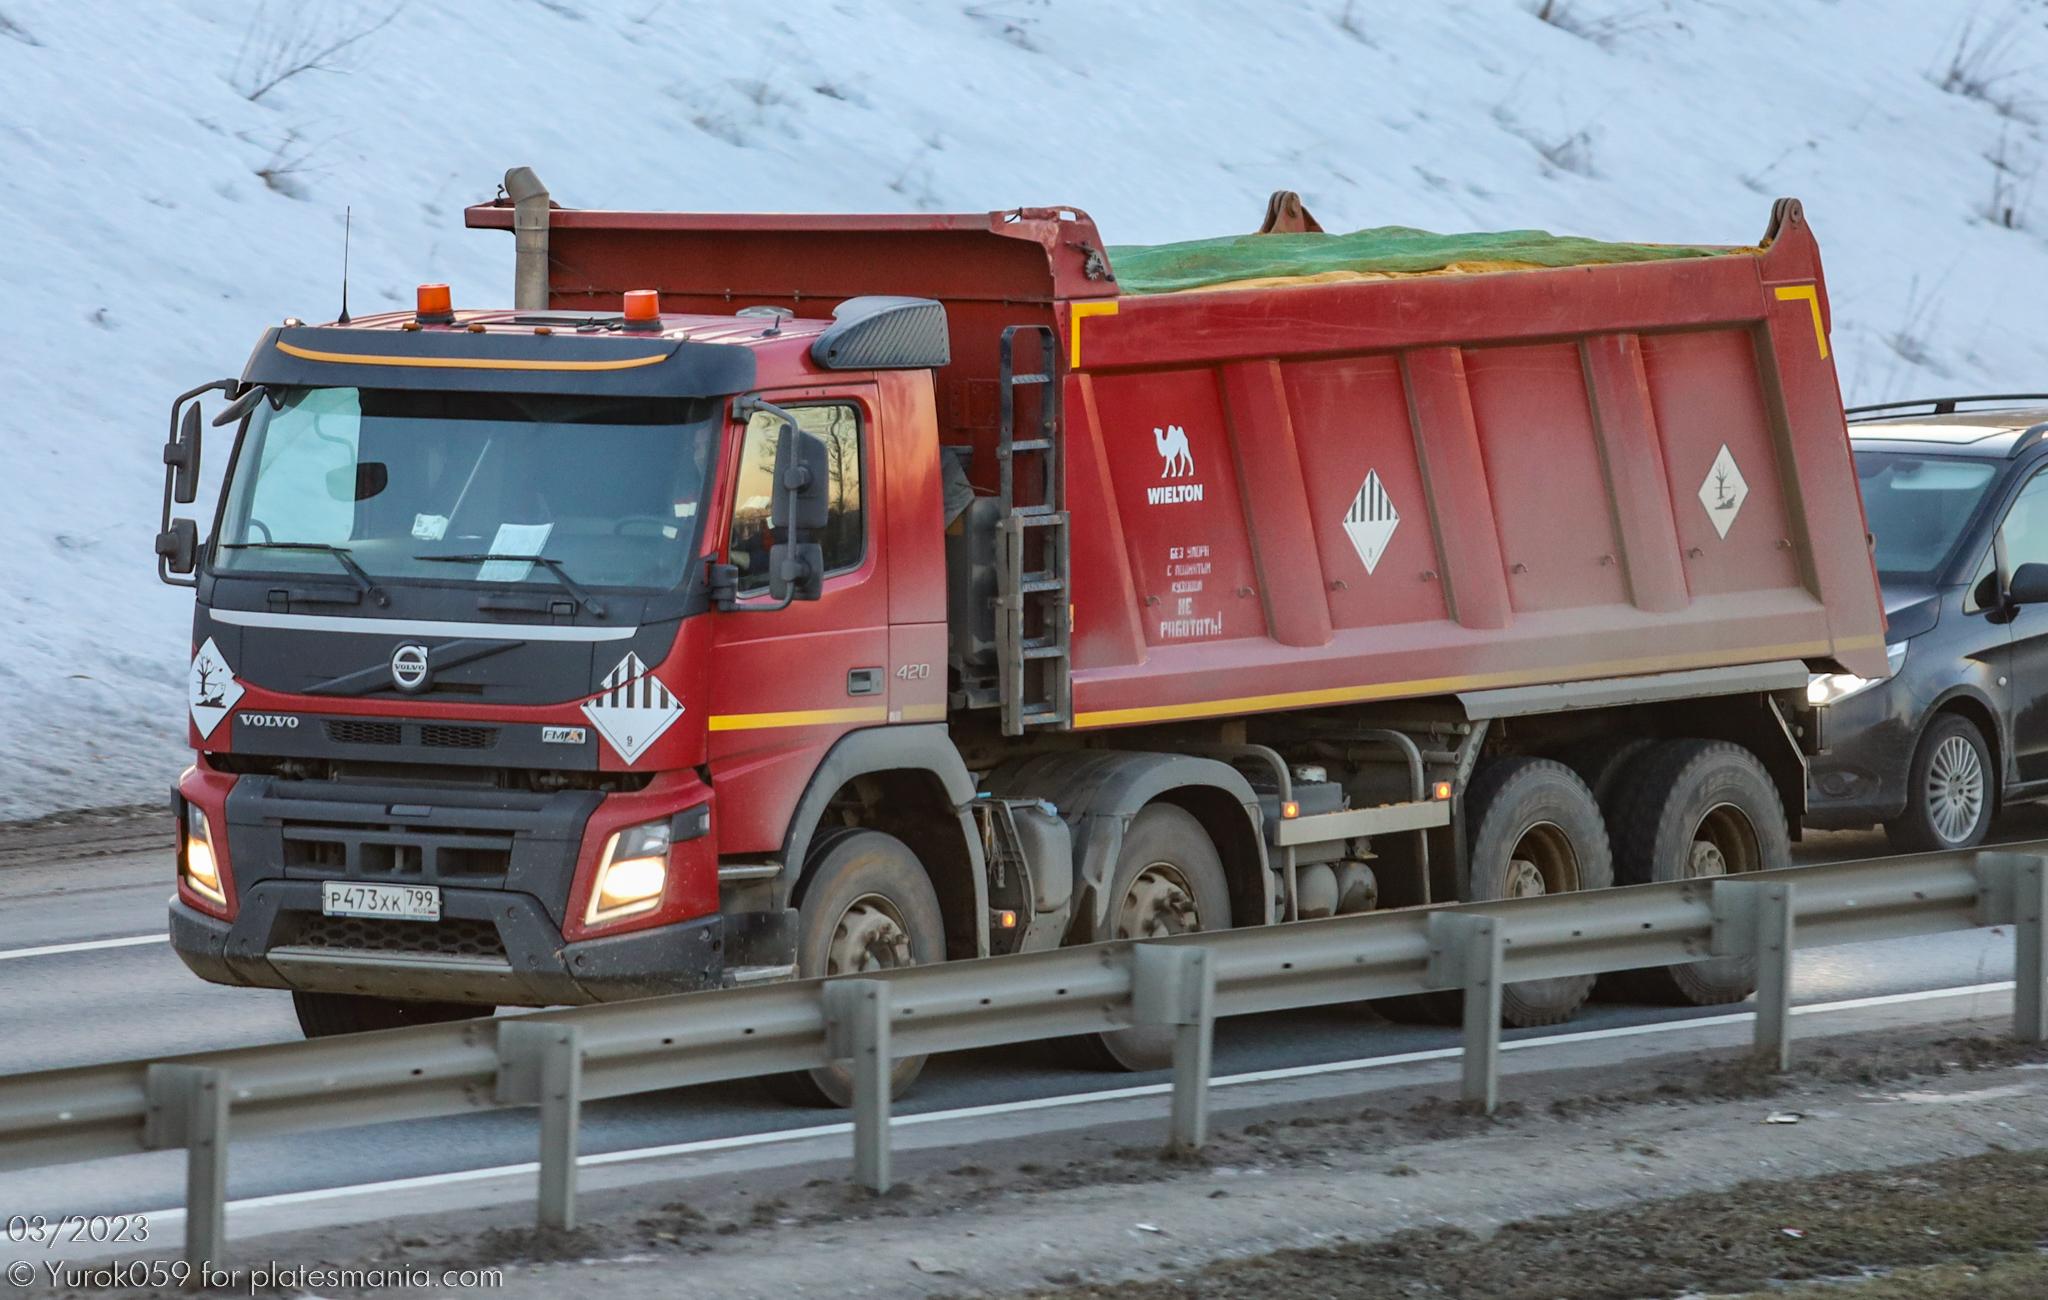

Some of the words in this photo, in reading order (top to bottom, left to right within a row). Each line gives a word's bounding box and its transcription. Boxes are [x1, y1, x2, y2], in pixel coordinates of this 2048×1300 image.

[1147, 484, 1203, 505] WIELTON
[394, 663, 425, 671] VOLVO
[896, 664, 930, 679] 420
[239, 714, 299, 728] VOLVO
[627, 735, 633, 746] 9
[406, 890, 433, 907] 799
